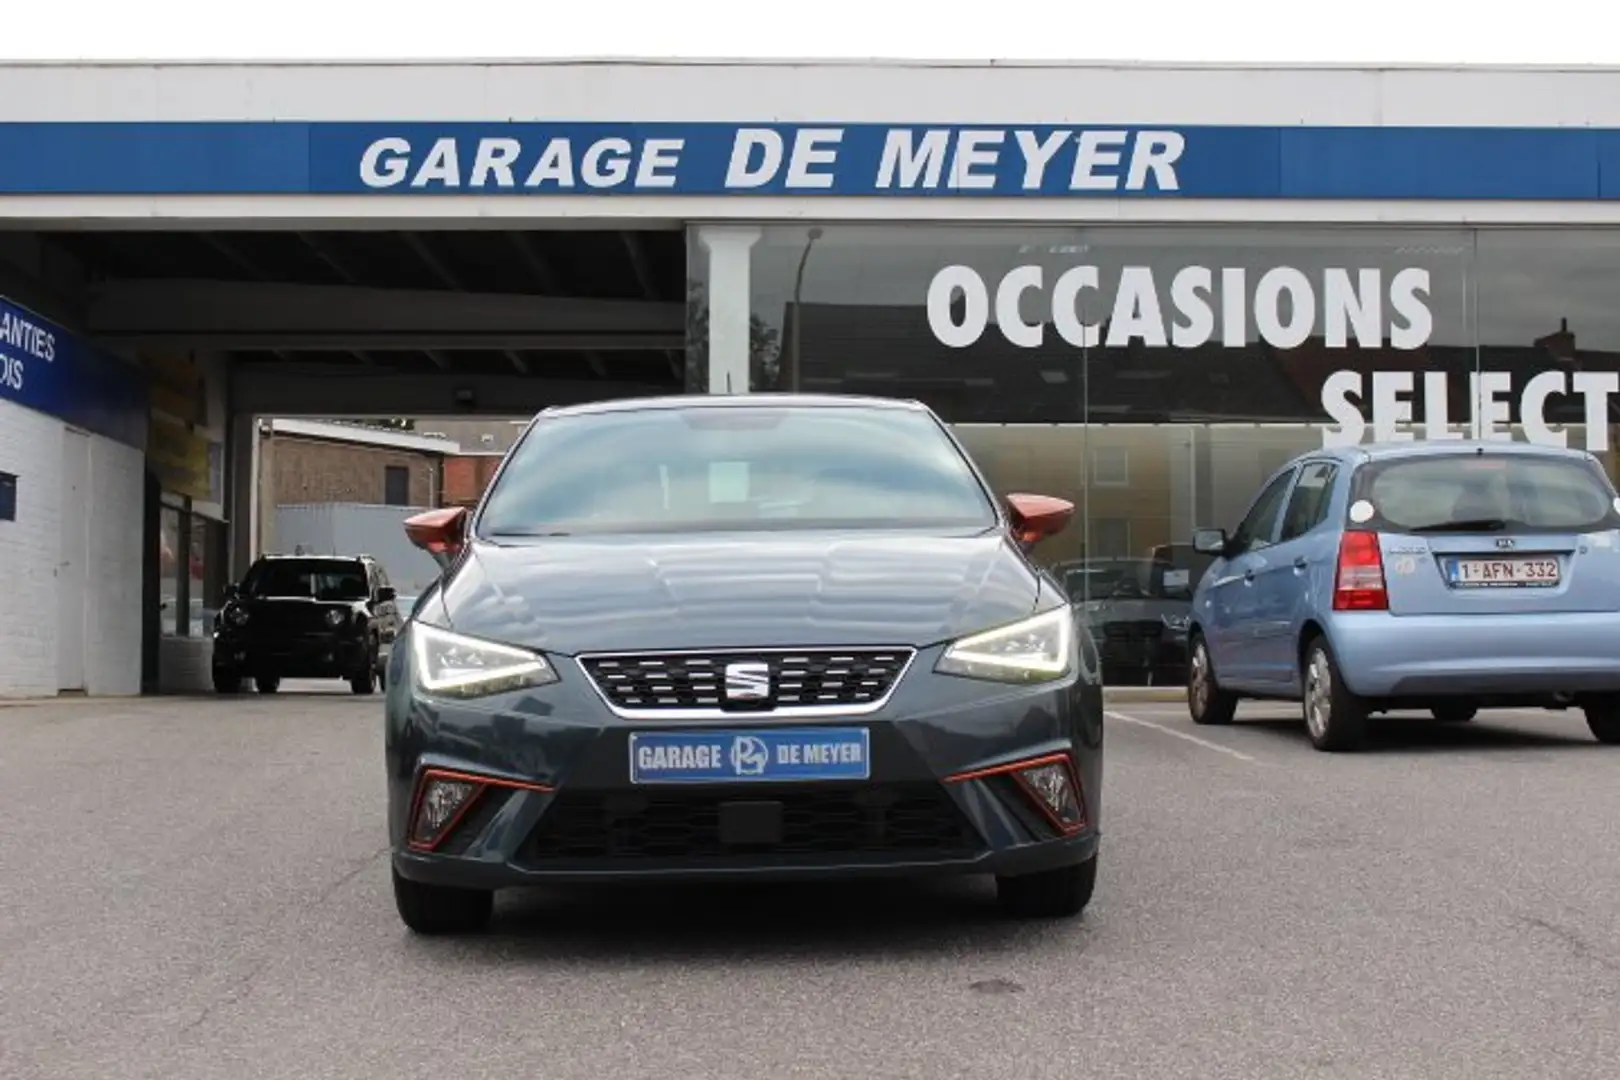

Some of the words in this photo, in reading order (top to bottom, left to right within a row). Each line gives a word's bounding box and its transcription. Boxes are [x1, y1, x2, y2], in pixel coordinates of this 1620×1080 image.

[359, 137, 685, 188] GARAGE
[724, 128, 845, 188] DE
[875, 129, 1185, 190] MEYER
[926, 265, 1433, 349] OCCASIONS
[1321, 370, 1619, 450] SELECT
[638, 744, 721, 769] GARAGE
[777, 744, 800, 764] DE
[803, 742, 862, 764] MEYER
